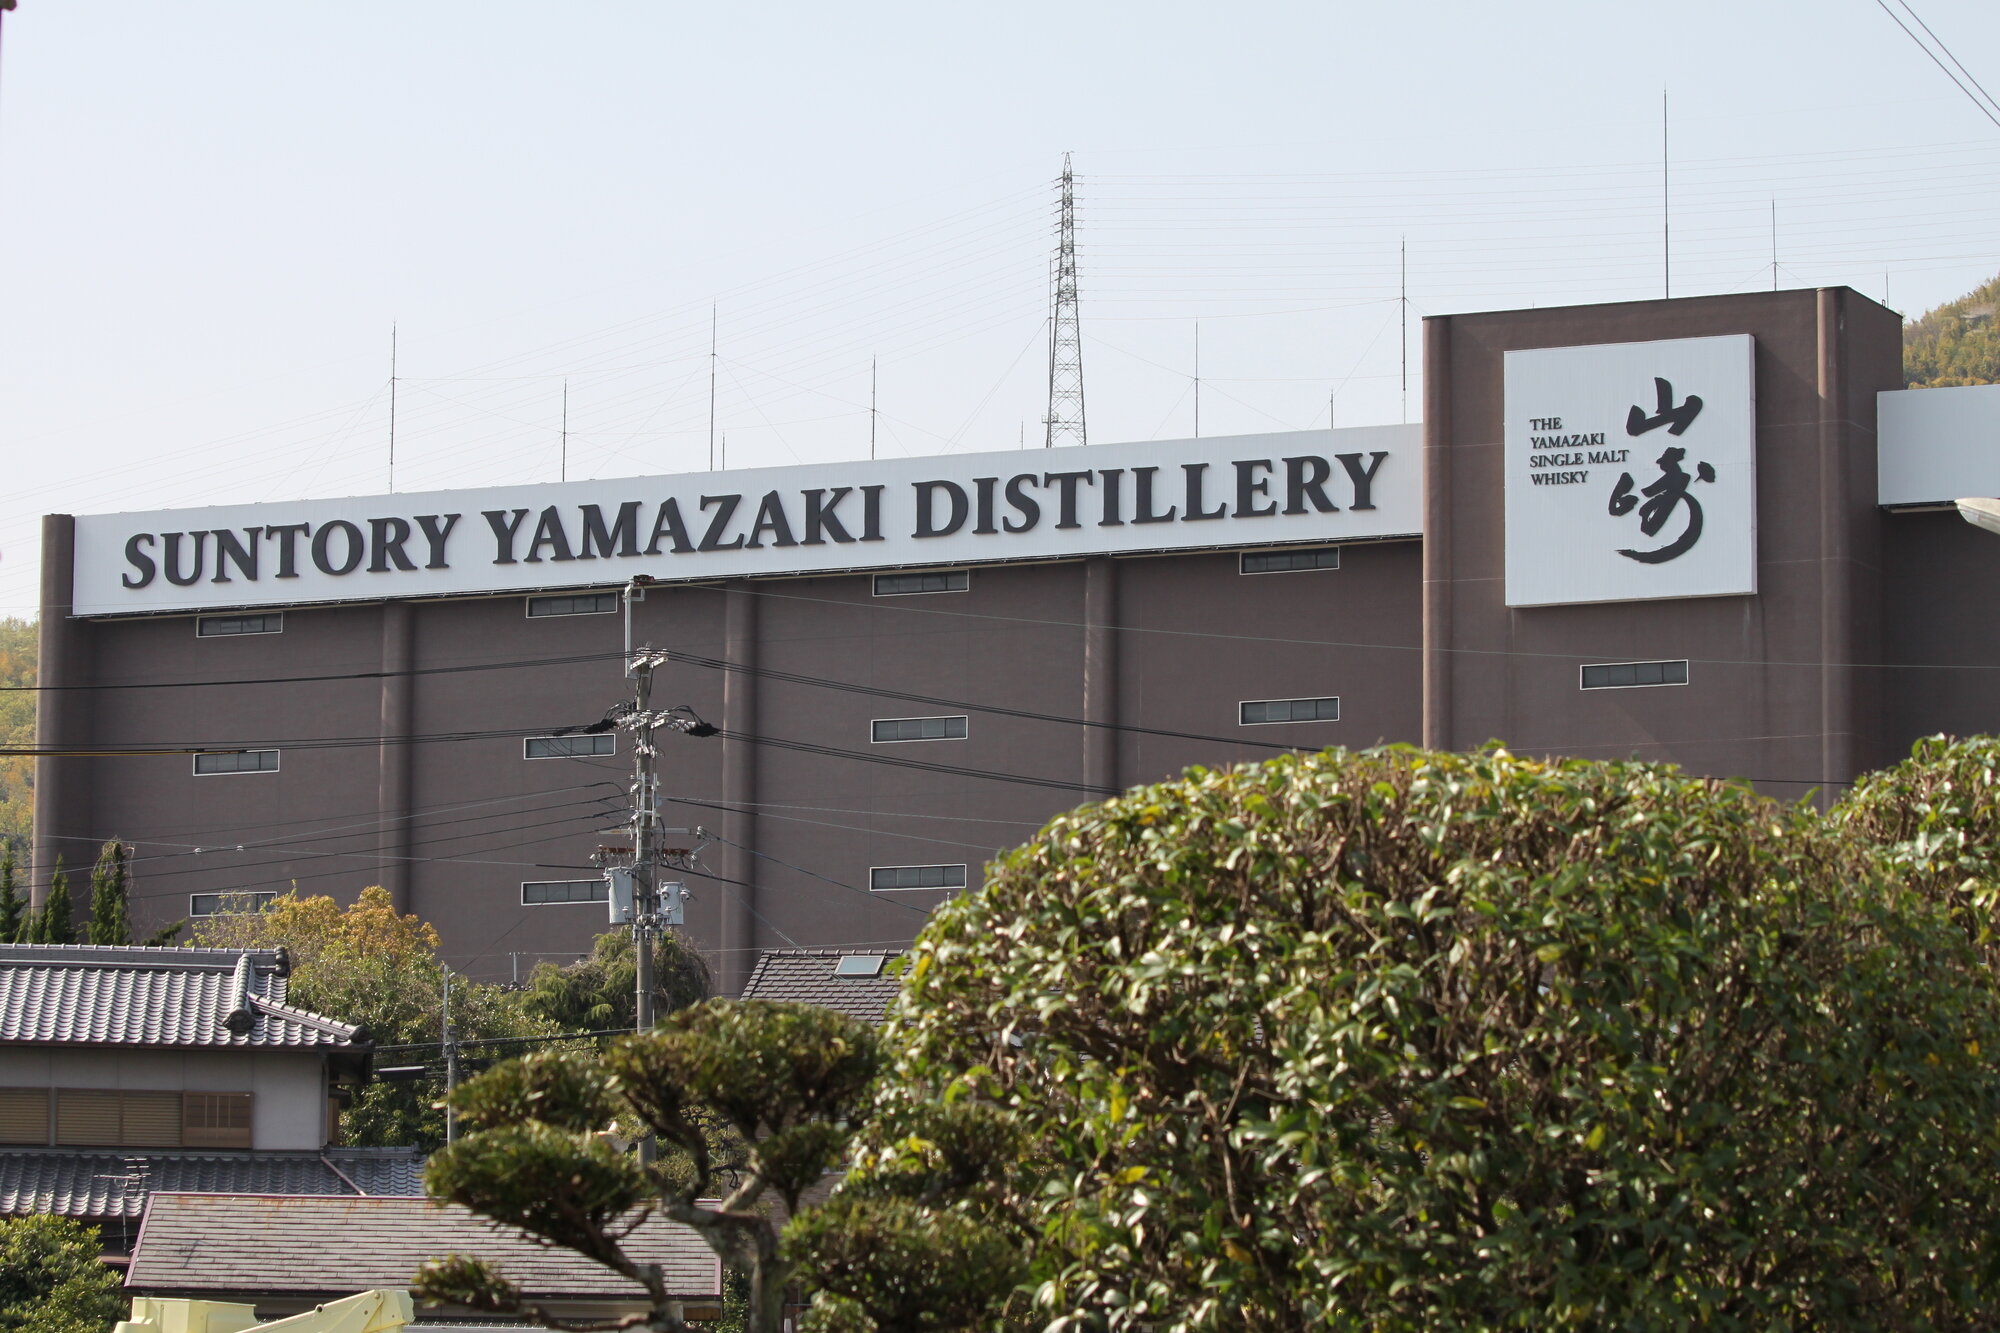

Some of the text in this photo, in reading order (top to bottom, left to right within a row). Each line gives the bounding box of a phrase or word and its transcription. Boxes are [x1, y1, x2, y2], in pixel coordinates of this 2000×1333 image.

[1529, 417, 1563, 432] THE
[1530, 433, 1605, 450] YAMAZAKI
[1530, 449, 1630, 468] SINGLE MALT
[1530, 470, 1589, 486] WHISKY
[121, 451, 1389, 590] SUNTORY YAMAZAKI DISTILLERY
